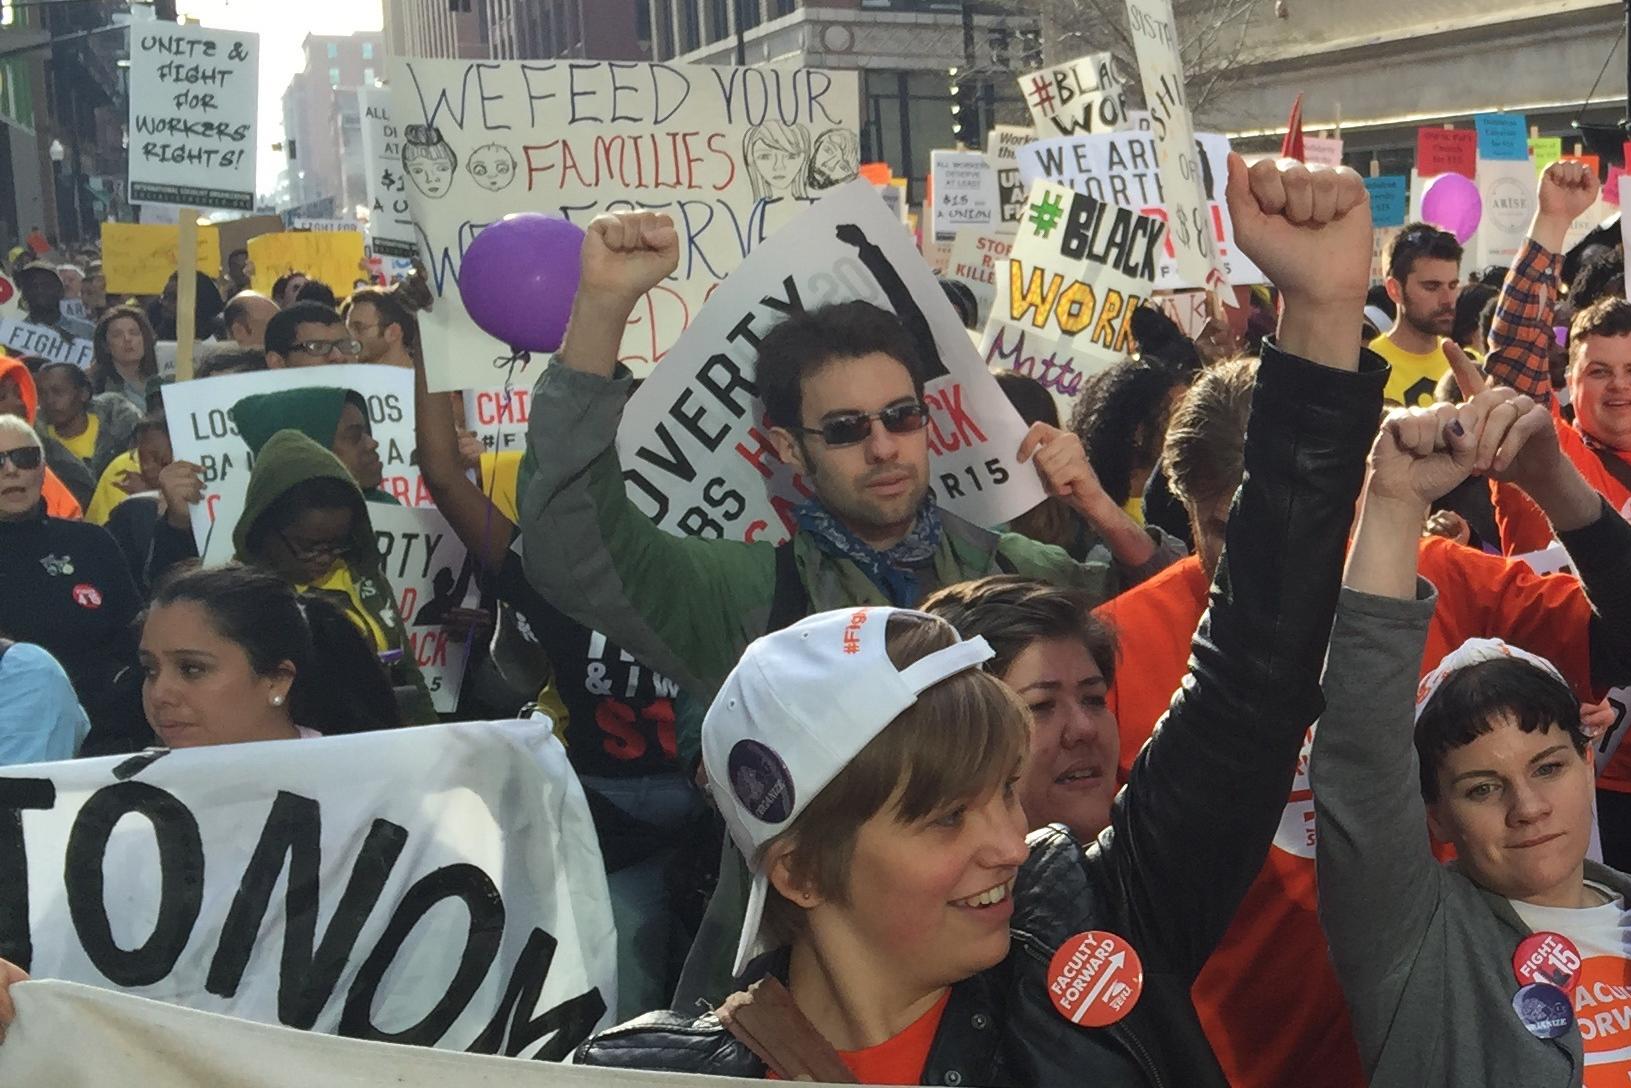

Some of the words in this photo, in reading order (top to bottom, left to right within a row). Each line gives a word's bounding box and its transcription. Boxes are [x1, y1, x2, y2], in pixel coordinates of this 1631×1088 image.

[141, 35, 216, 58] UNITE
[228, 41, 248, 62] &
[157, 60, 233, 88] FIGHT
[173, 89, 218, 112] FOR
[365, 107, 390, 121] ALL
[406, 63, 510, 131] WE
[520, 62, 692, 128] FEED
[711, 66, 843, 128] YOUR
[522, 131, 737, 192] FAMILIES
[1035, 144, 1092, 178] WE
[1028, 188, 1166, 282] #BLACK
[9, 326, 74, 362] FIGHT
[585, 661, 613, 696] &
[1051, 932, 1098, 995] FACULTY
[1519, 934, 1559, 979] FIGHT
[1060, 938, 1116, 1011] FORWARD
[1109, 984, 1134, 1013] SEIU
